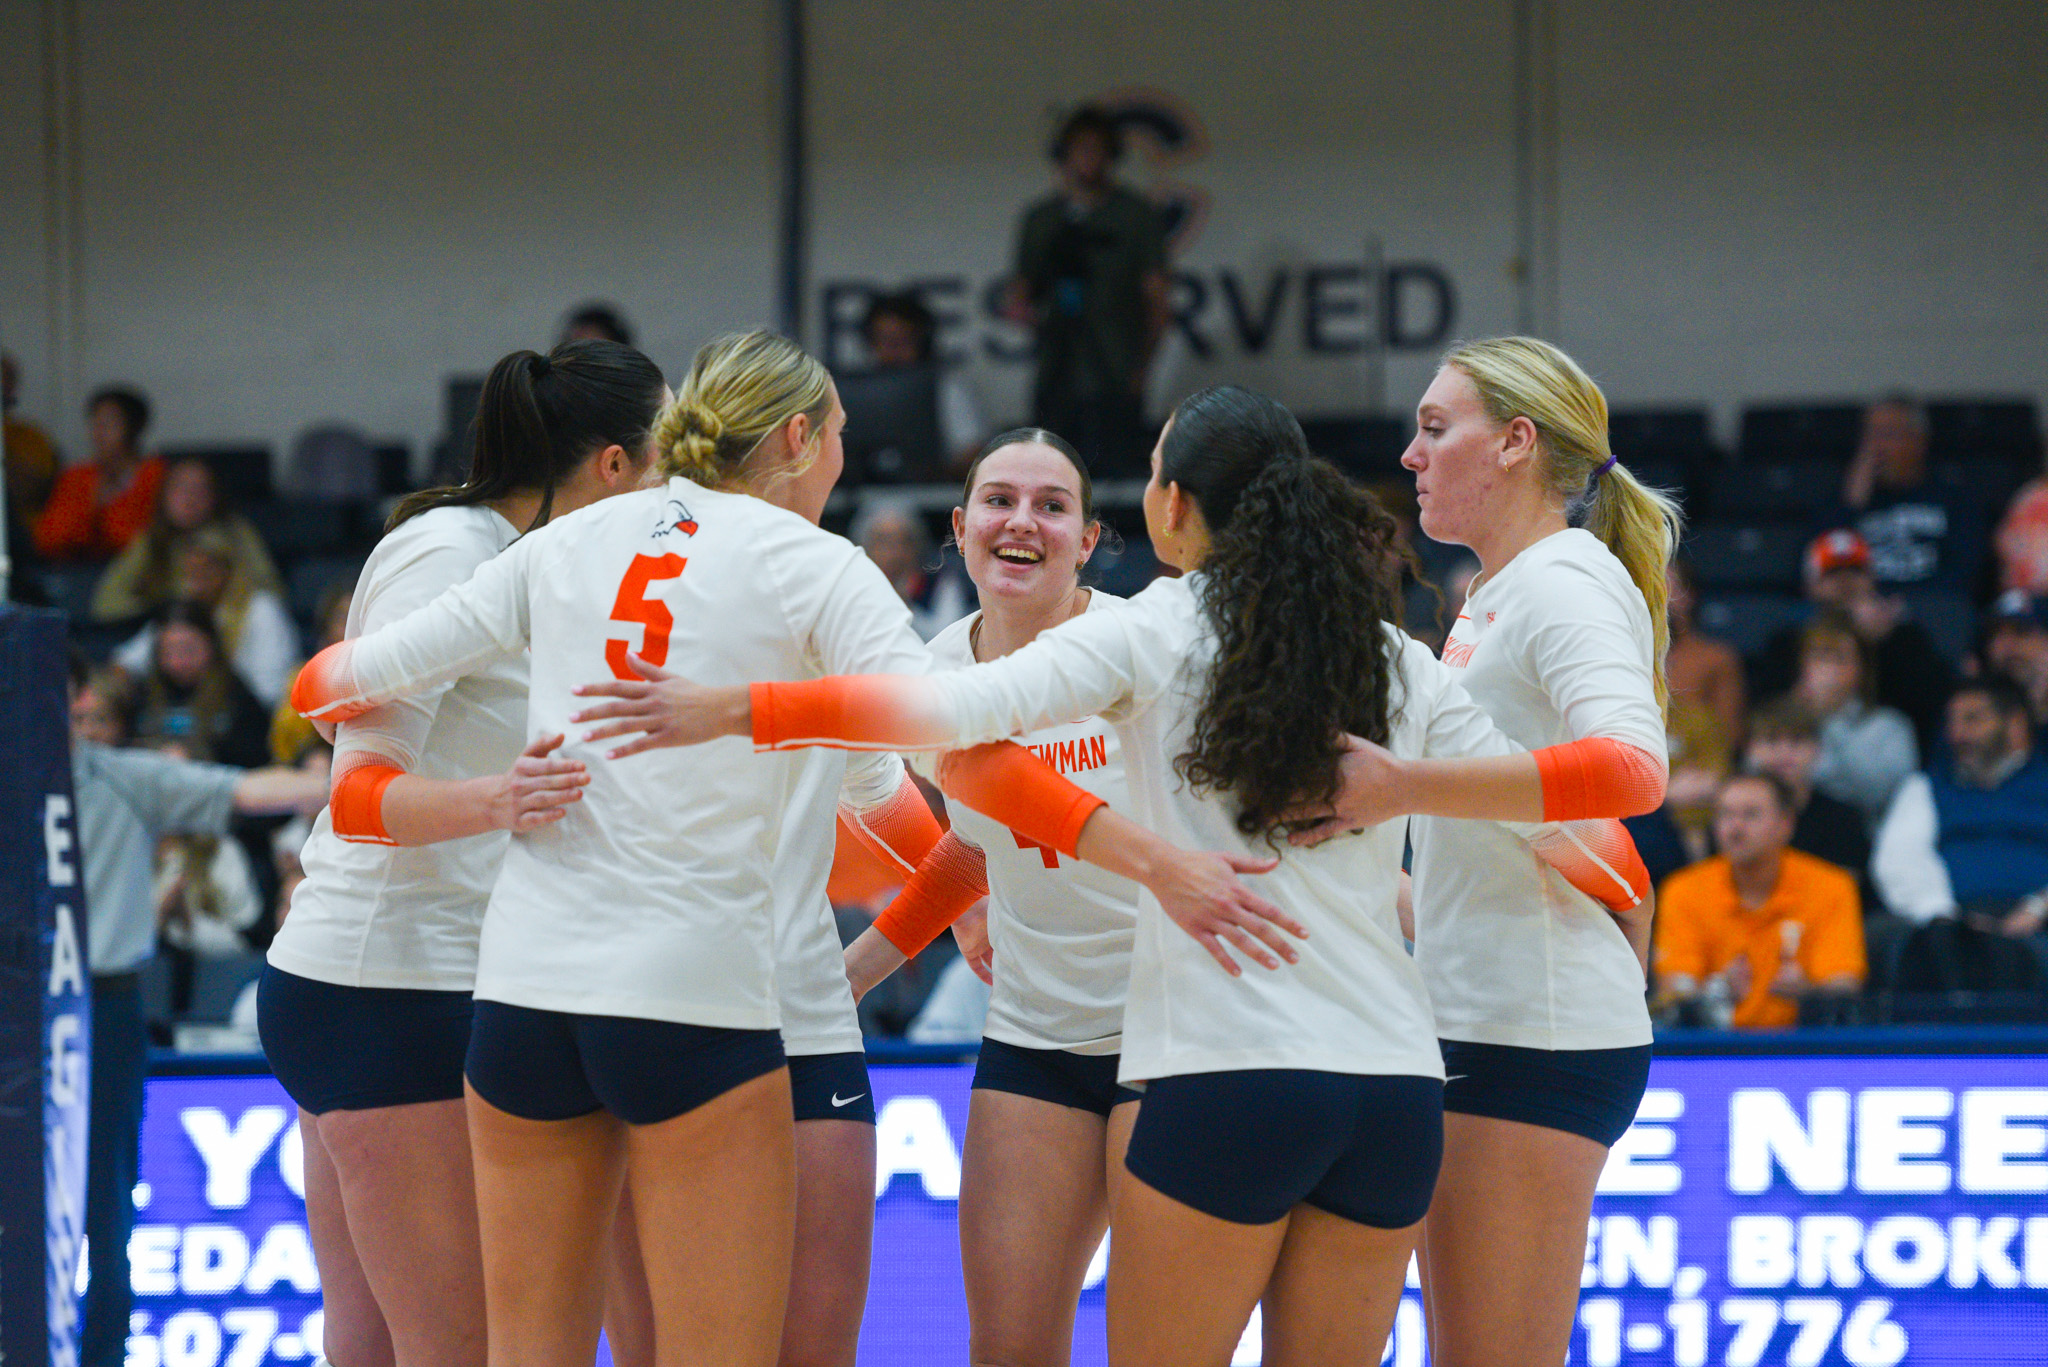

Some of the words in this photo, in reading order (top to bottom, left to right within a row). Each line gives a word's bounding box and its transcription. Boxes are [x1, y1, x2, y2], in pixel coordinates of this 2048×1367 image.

[821, 262, 1459, 376] RESRVED
[605, 551, 688, 682] 5
[1023, 734, 1107, 775] WMAN
